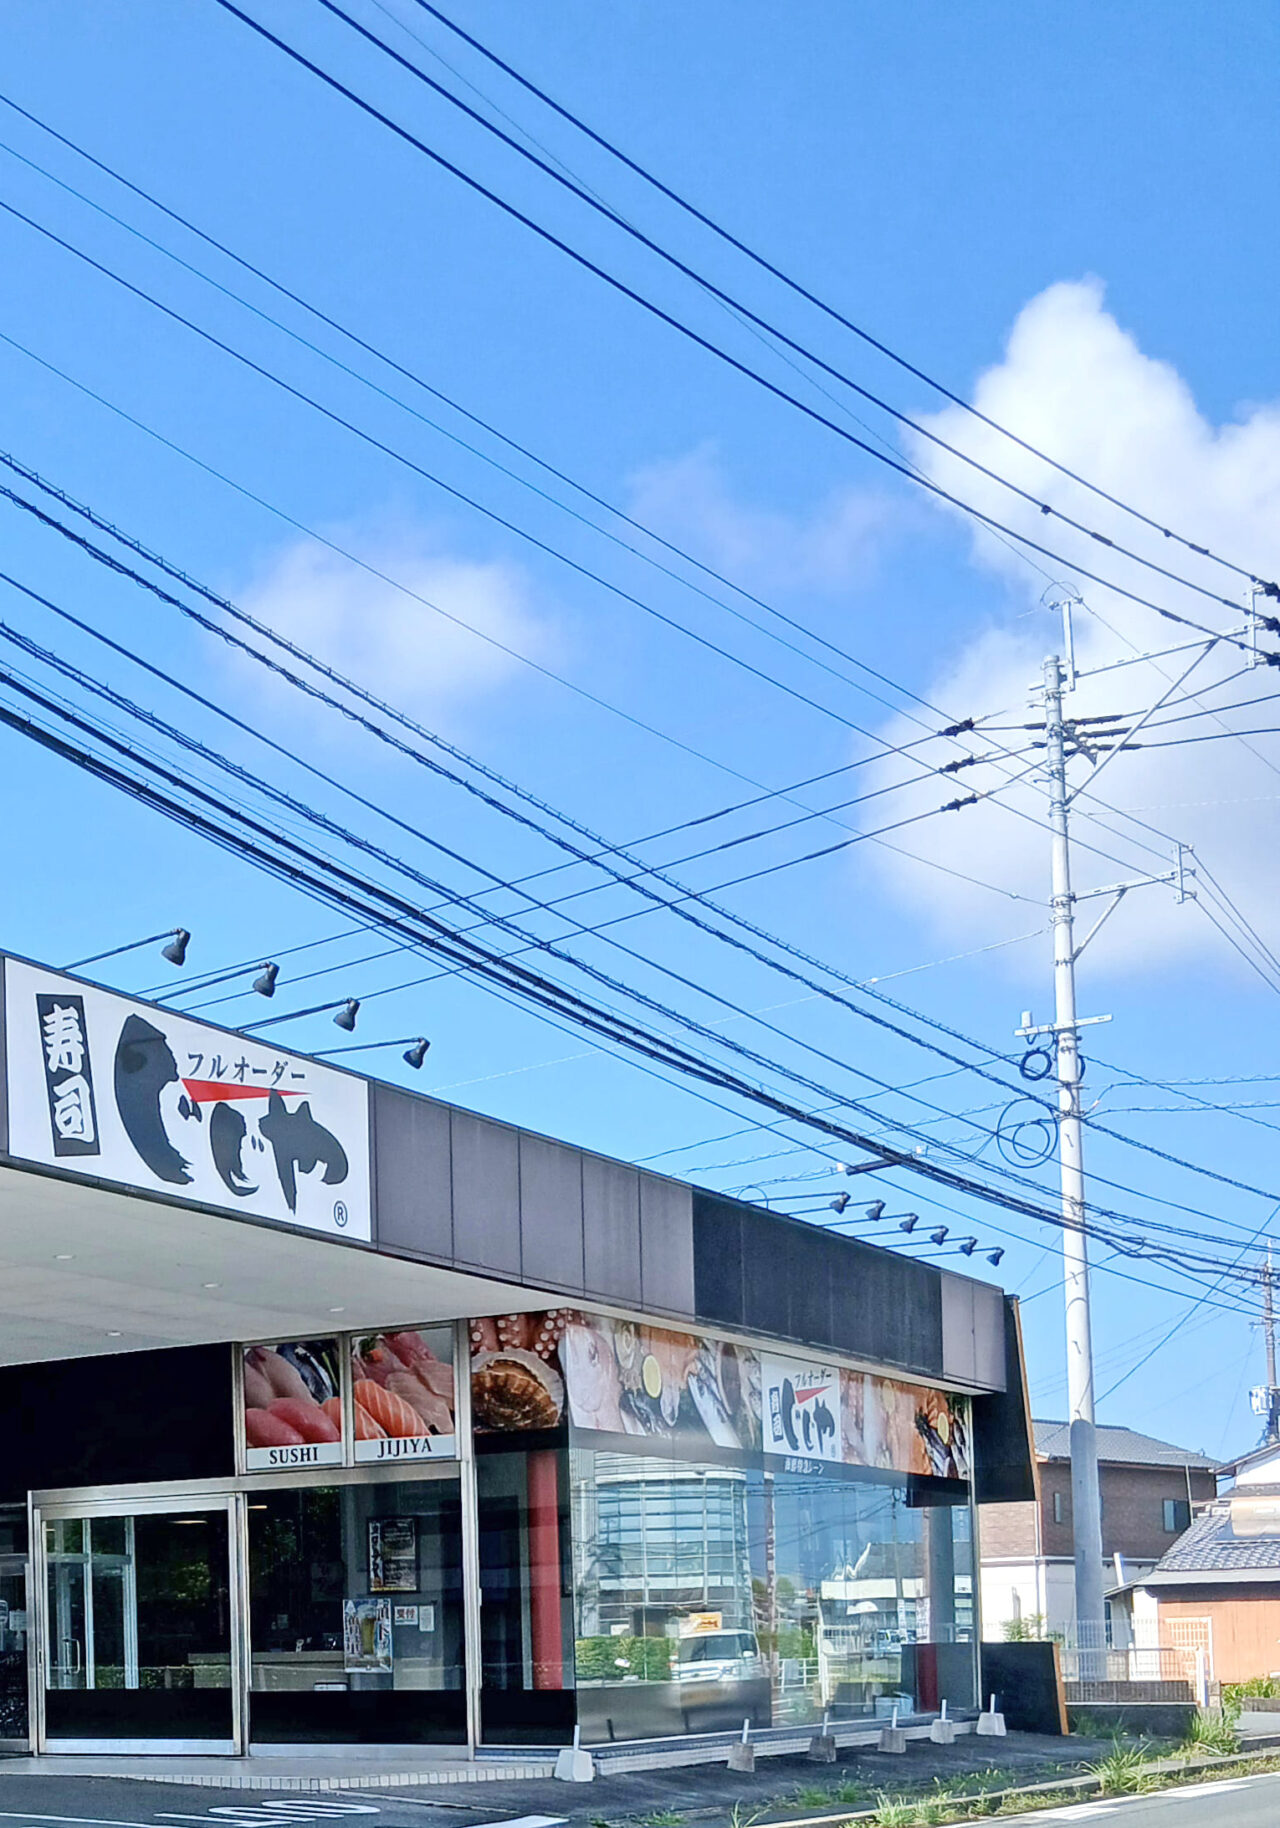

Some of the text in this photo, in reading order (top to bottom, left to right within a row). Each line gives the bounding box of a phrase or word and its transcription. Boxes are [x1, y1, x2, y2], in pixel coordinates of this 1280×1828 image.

[43, 1003, 95, 1144] 寿司
[187, 1052, 306, 1086] フルオーダー
[269, 1446, 319, 1465] SUSHI
[377, 1438, 432, 1458] JIJIYA
